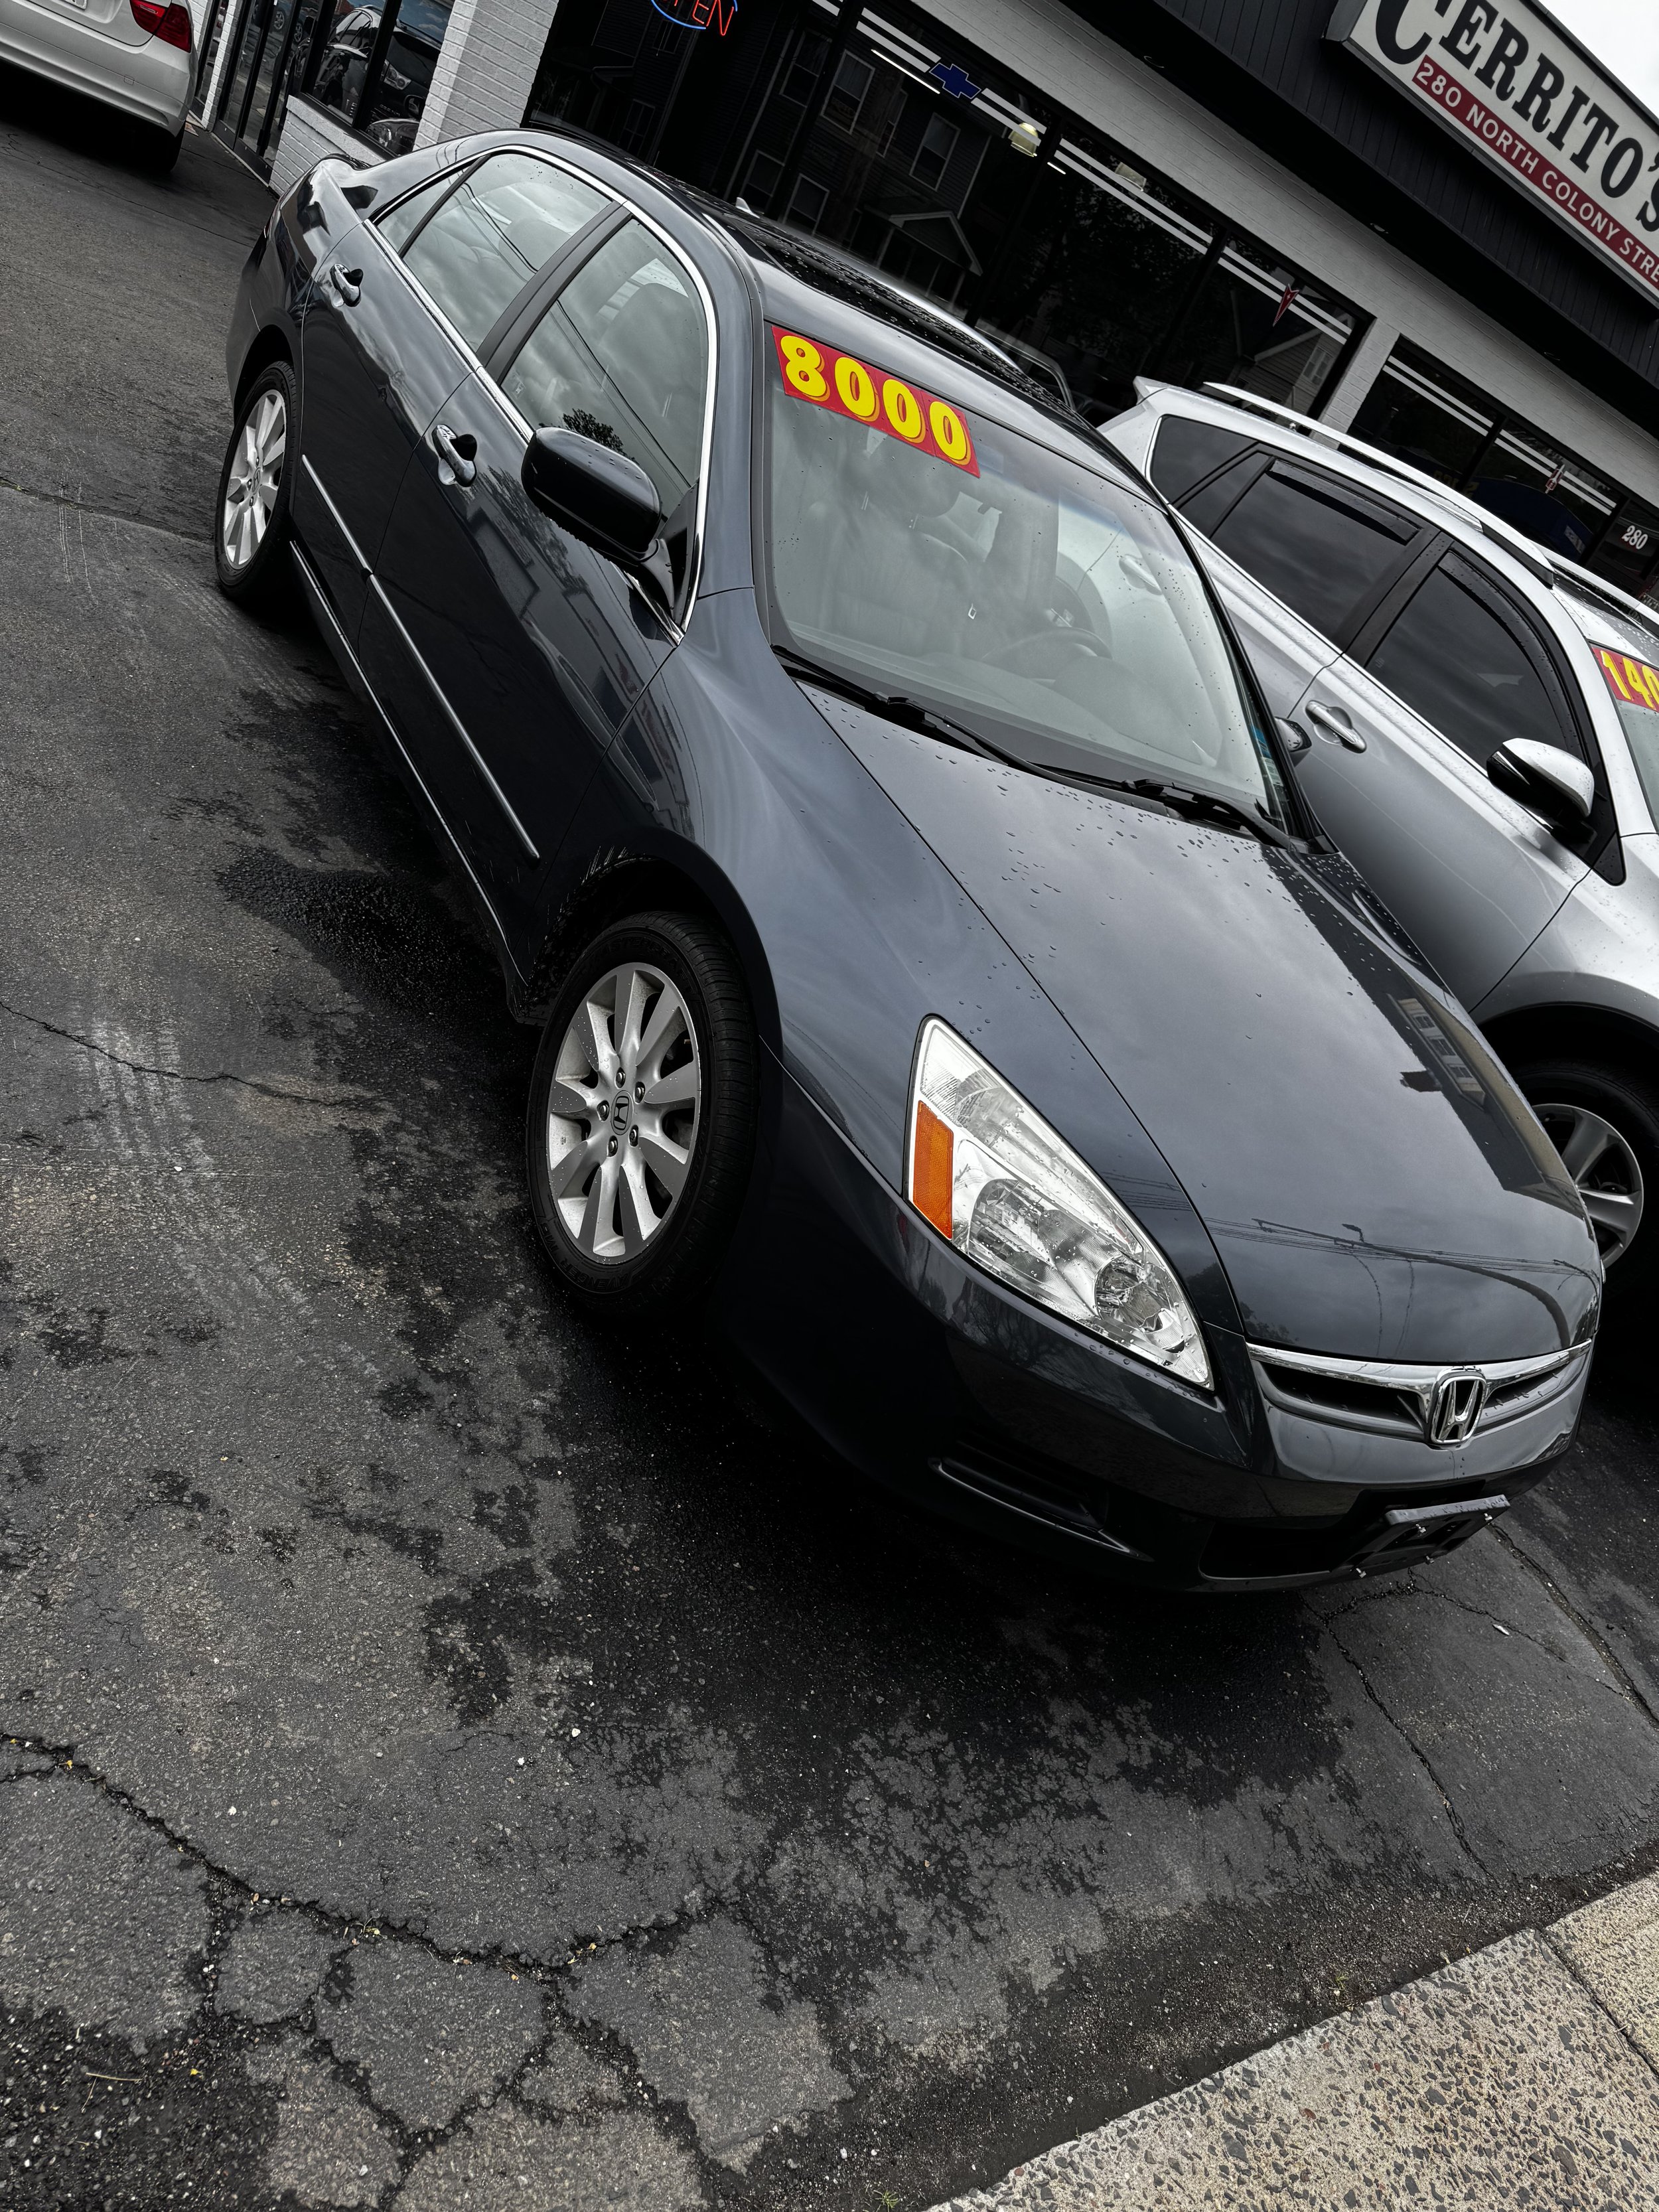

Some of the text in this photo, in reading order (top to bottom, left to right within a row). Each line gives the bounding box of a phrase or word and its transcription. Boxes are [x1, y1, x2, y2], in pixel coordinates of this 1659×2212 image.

[1416, 63, 1461, 108] 280
[1465, 104, 1540, 175] NORTH
[1542, 170, 1621, 242] COLONY
[780, 335, 972, 465] 8000
[1621, 525, 1648, 550] 280
